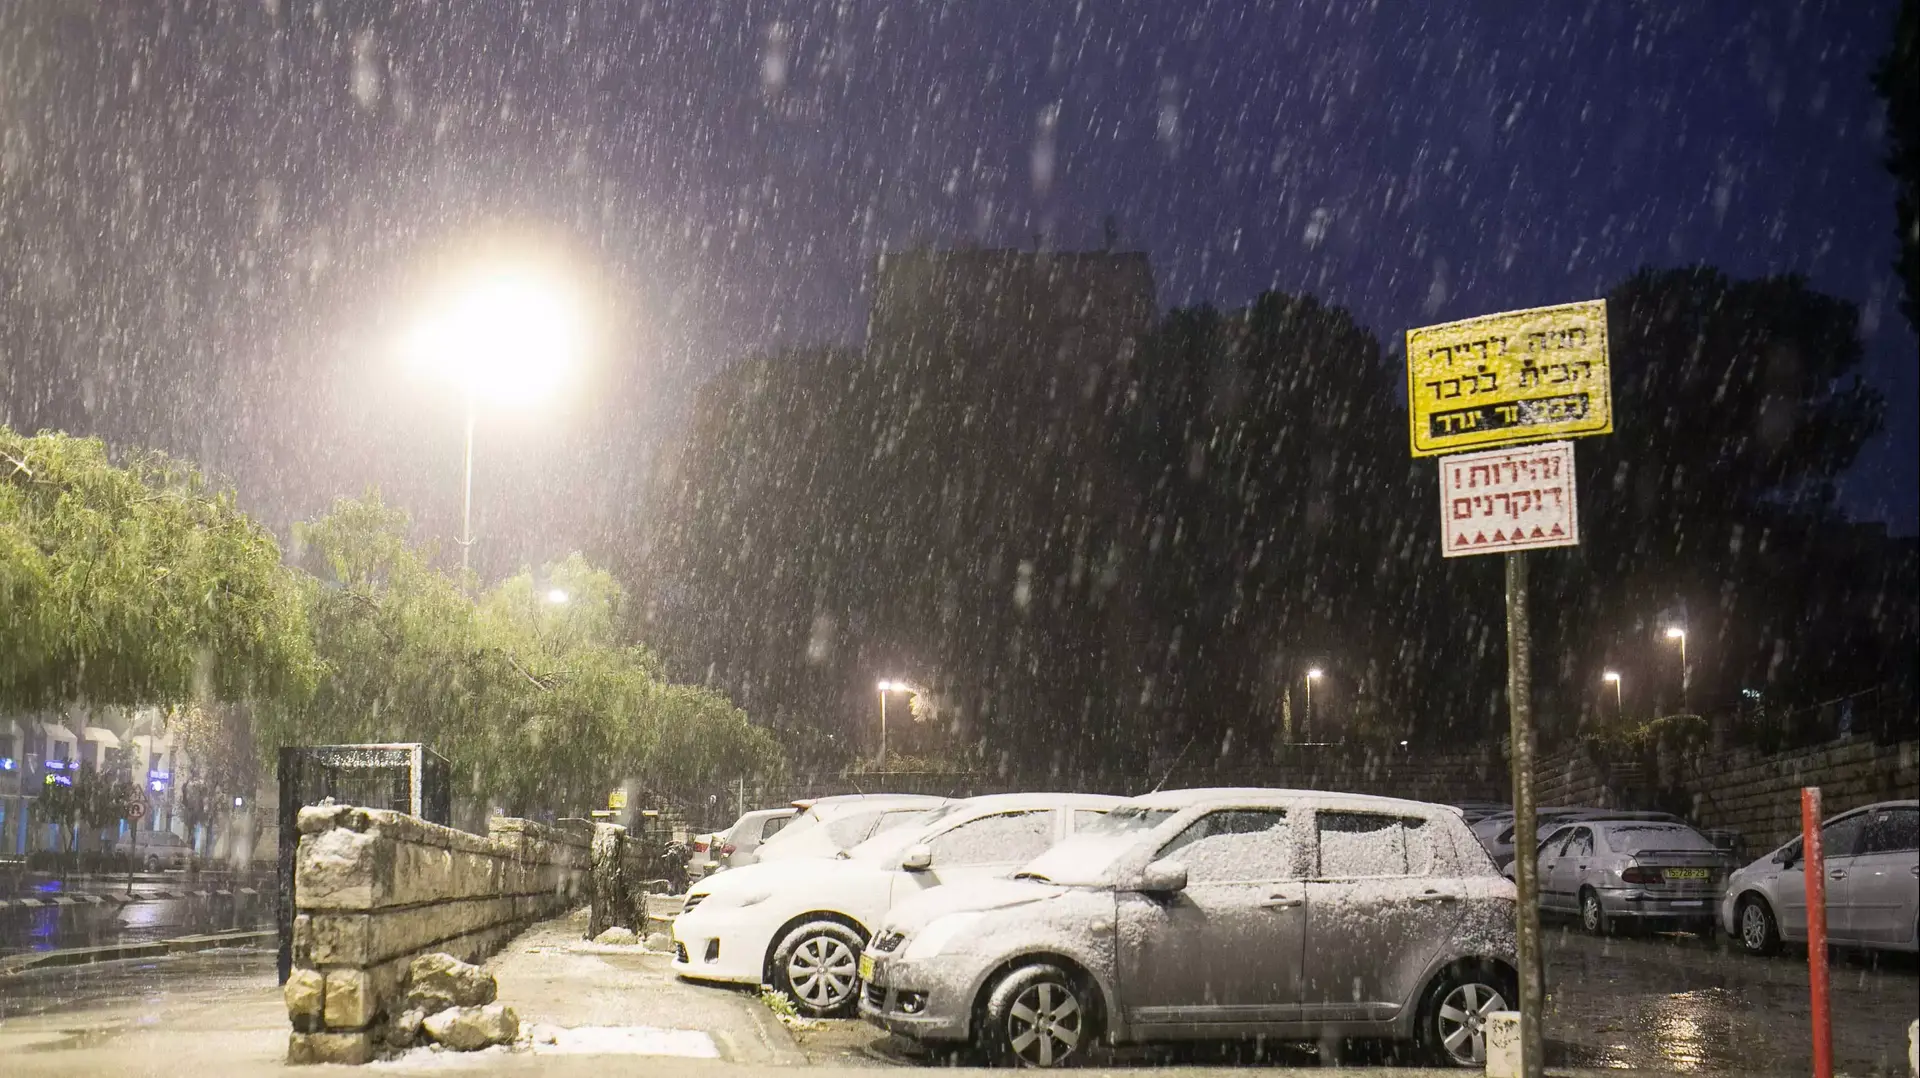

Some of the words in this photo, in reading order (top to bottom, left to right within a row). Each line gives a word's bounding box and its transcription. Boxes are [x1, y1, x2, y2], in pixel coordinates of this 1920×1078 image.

[1425, 371, 1499, 400] בלבד
[1518, 360, 1592, 388] הבית
[1494, 405, 1519, 424] זר
[1453, 487, 1562, 519] דוקרנים
